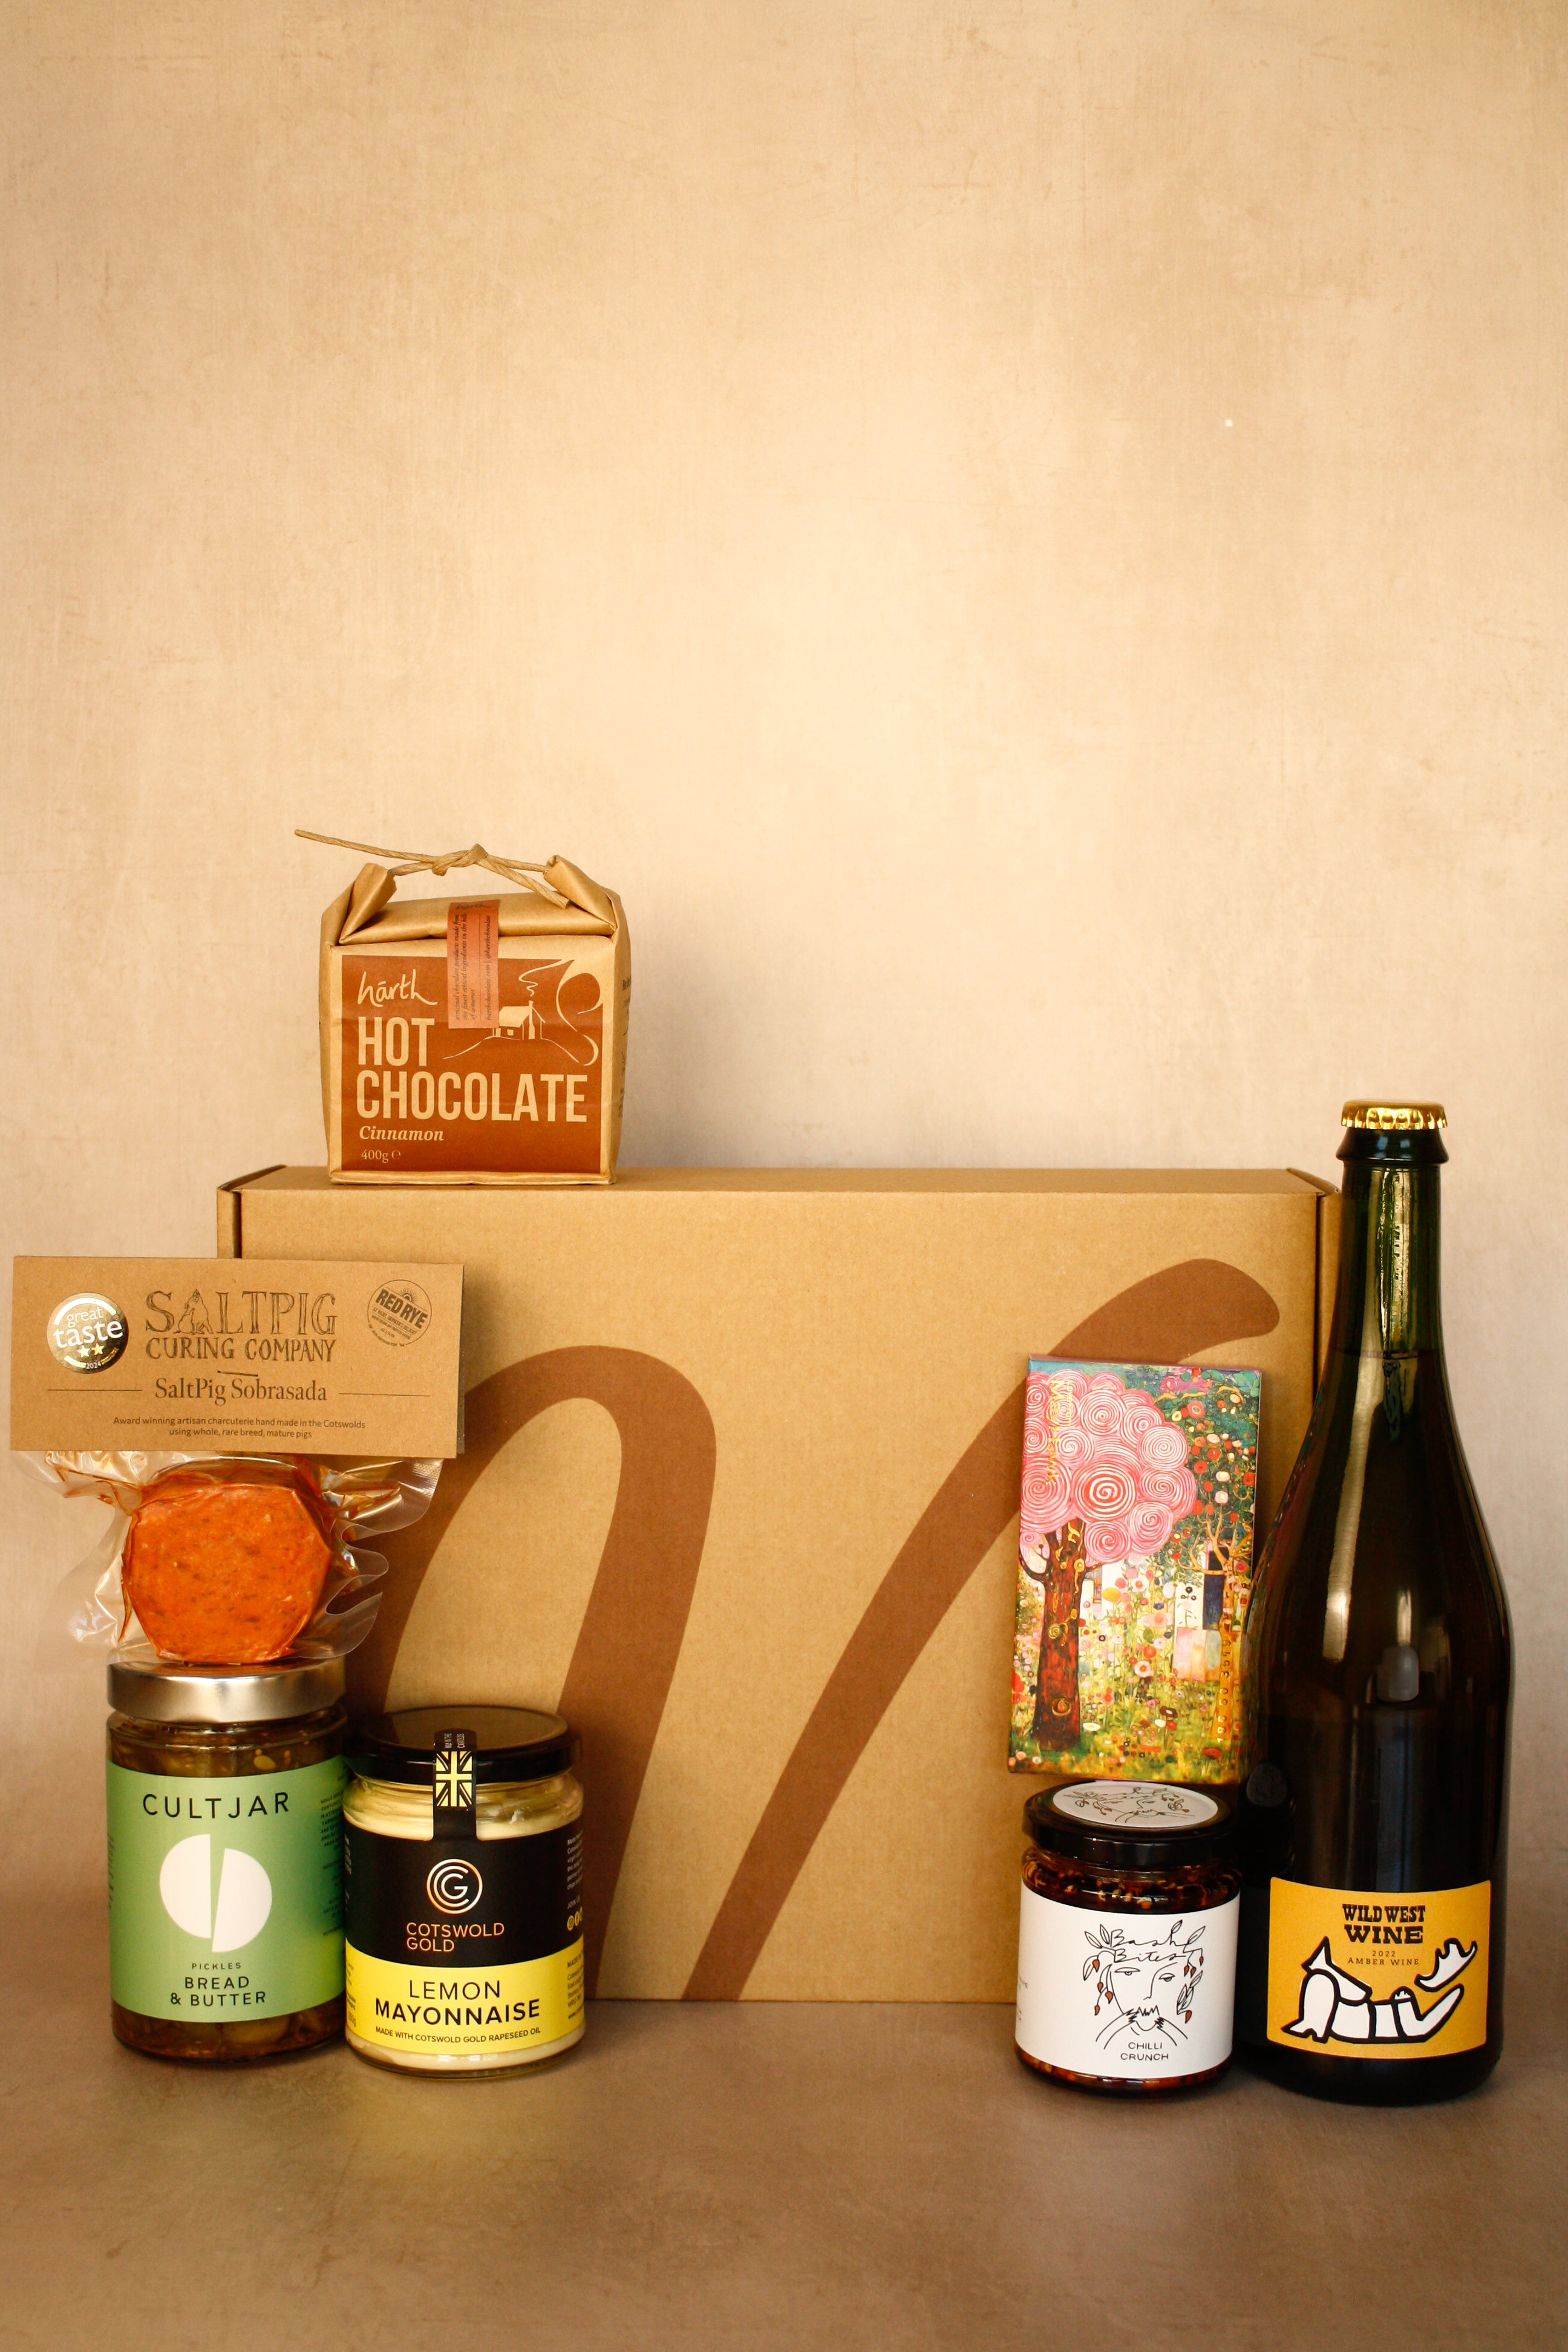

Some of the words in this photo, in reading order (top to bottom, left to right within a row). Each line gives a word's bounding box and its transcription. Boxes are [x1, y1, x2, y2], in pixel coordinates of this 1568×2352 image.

[358, 1016, 435, 1067] HOT
[356, 1070, 588, 1123] CHOCOLATE
[359, 1125, 445, 1142] Cinnamon
[361, 1149, 389, 1163] 400g
[67, 1307, 103, 1328] great
[375, 1288, 403, 1314] RED
[400, 1302, 428, 1330] RYE
[53, 1320, 123, 1348] taste
[145, 1337, 235, 1359] CURING
[245, 1338, 336, 1362] COMPANY
[86, 1361, 102, 1370] 2024
[155, 1377, 226, 1406] SaltPig
[231, 1377, 327, 1401] Sobrasada
[113, 1416, 140, 1425] Award
[142, 1417, 175, 1426] winning
[177, 1416, 206, 1425] artisan
[207, 1416, 254, 1426] charcuterie
[255, 1417, 276, 1426] hand
[276, 1418, 298, 1426] made
[299, 1418, 307, 1426] in
[309, 1419, 322, 1427] the
[323, 1419, 365, 1428] Cotswolds
[169, 1428, 192, 1437] using
[193, 1428, 221, 1437] whole,
[240, 1428, 266, 1438] breed,
[267, 1429, 295, 1438] mature
[296, 1429, 312, 1439] pigs
[1342, 1903, 1382, 1922] WILD
[1384, 1905, 1426, 1923] WEST
[406, 1922, 505, 1938] COTSWOLD
[1344, 1924, 1423, 1944] WINE
[406, 1936, 455, 1952] GOLD
[191, 1961, 242, 1970] PICKLES
[1348, 1957, 1385, 1965] AMBER
[185, 1975, 250, 1990] BREAD
[409, 1979, 501, 2001] LEMON
[170, 1993, 181, 2005] &
[191, 1991, 266, 2007] BUTTER
[375, 1998, 540, 2026] MAYONNAISE
[375, 2026, 394, 2037] MADE
[395, 2030, 413, 2040] WITH
[415, 2033, 461, 2043] COTSWOLD
[463, 2034, 486, 2043] GOLD
[488, 2030, 529, 2042] RAPESEED
[530, 2026, 541, 2036] OIL
[1128, 2041, 1163, 2050] CHILLI
[1120, 2053, 1169, 2061] CRUNCH
